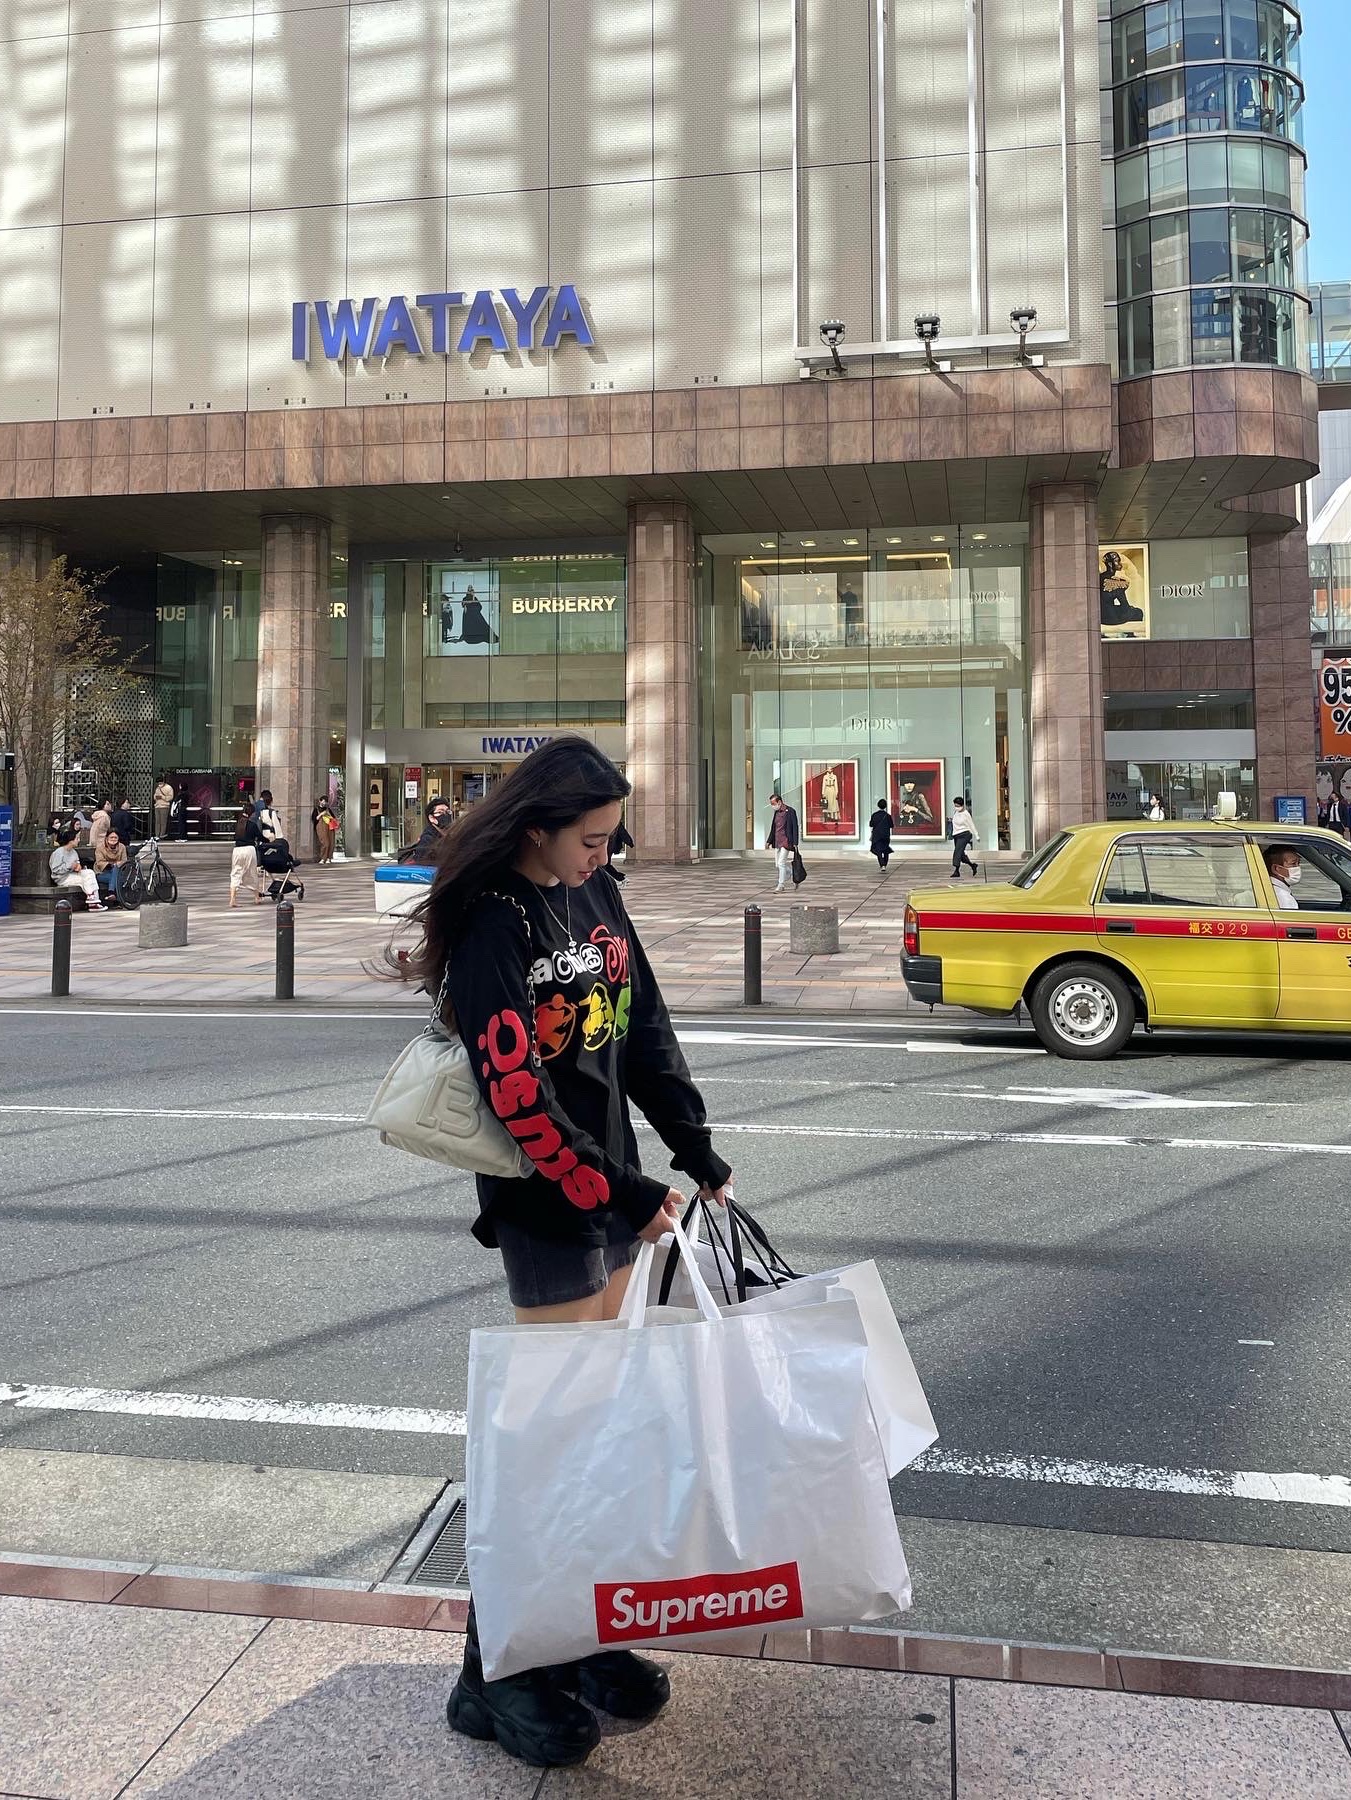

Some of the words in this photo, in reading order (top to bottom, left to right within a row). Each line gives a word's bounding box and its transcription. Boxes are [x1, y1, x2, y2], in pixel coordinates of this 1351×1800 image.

[292, 285, 594, 361] IWATAYA
[969, 591, 1007, 603] DIOR
[1161, 584, 1204, 598] DIOR
[512, 596, 618, 614] BURBERRY
[851, 717, 892, 731] DIOR
[610, 1583, 789, 1635] Supreme
